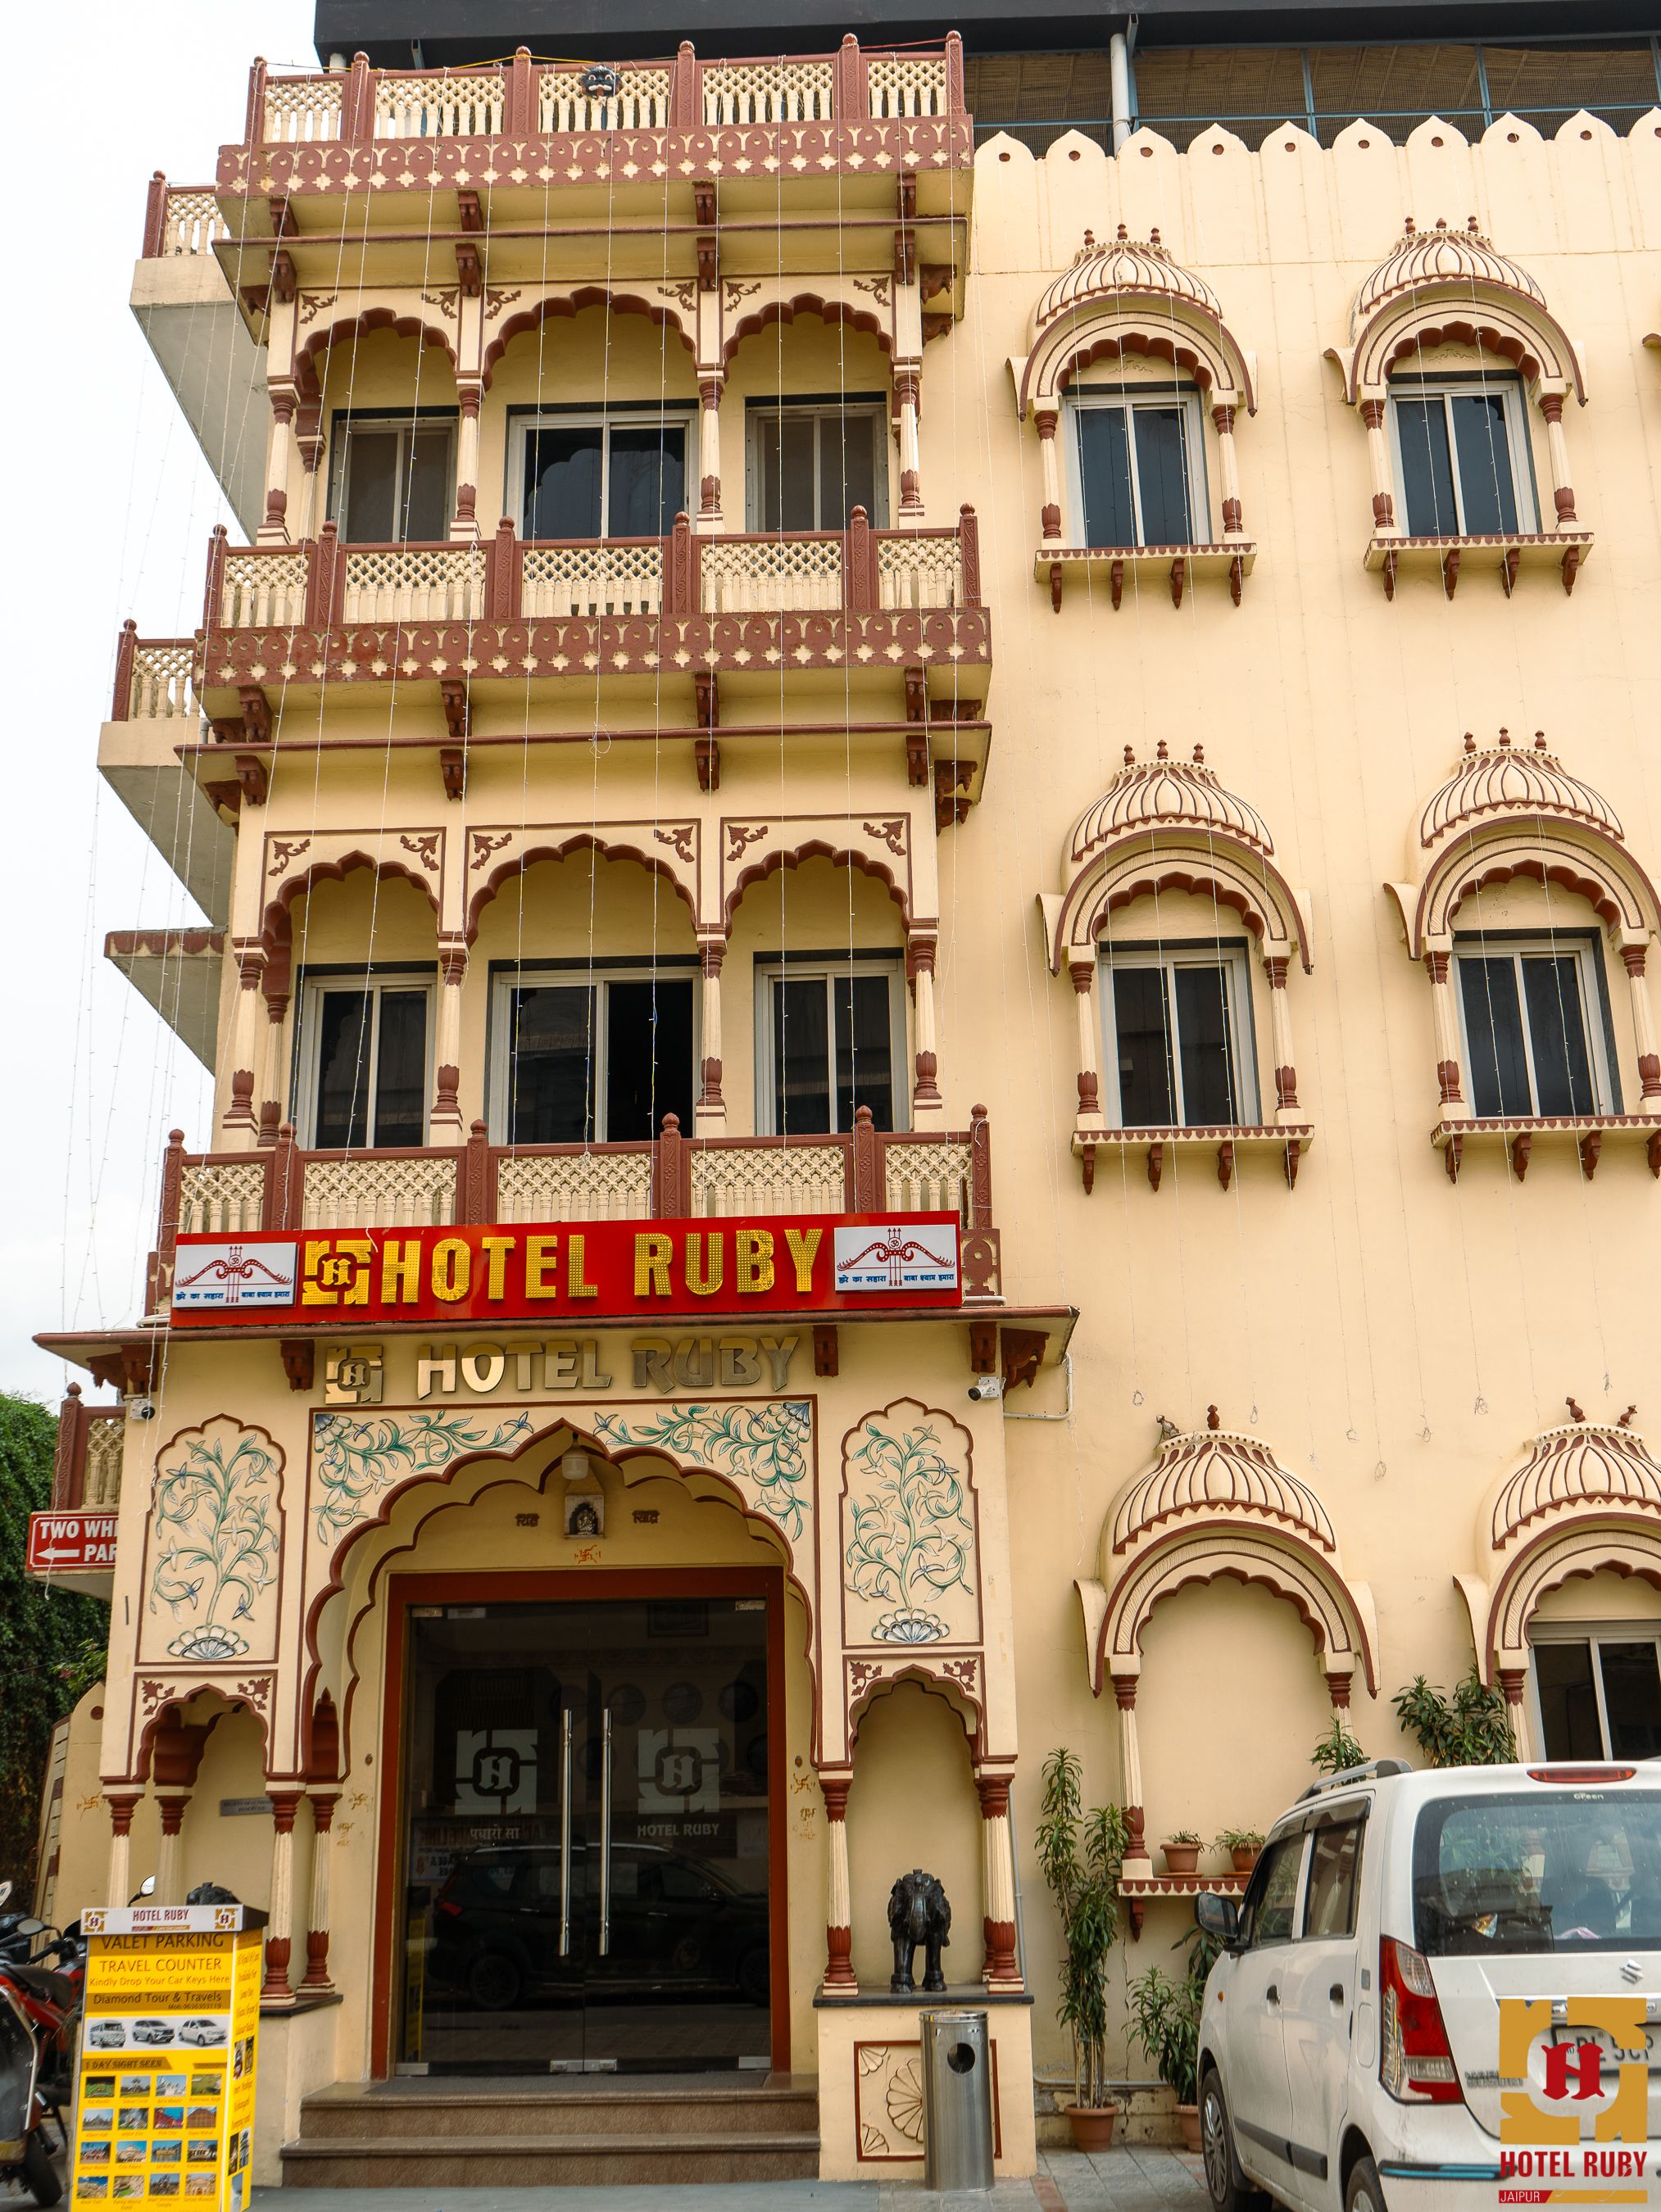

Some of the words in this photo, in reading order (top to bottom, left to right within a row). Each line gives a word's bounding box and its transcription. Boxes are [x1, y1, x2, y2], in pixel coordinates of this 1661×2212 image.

[381, 1234, 599, 1304] HOTEL
[633, 1228, 824, 1297] RUBY
[866, 1275, 887, 1283] सहारा
[190, 1292, 201, 1300] का
[203, 1292, 224, 1300] सहारा
[275, 1290, 290, 1299] हमारा
[417, 1339, 612, 1401] HOTEL
[631, 1336, 801, 1394] RUBY
[40, 1521, 79, 1539] TWO
[470, 1824, 501, 1841] पधारो
[506, 1827, 520, 1840] सा
[638, 1824, 679, 1837] HOTEL
[683, 1823, 719, 1837] RUBY
[133, 1910, 161, 1922] HOTEL
[164, 1909, 190, 1921] RUBY
[101, 1935, 150, 1950] VALET
[156, 1933, 224, 1949] PARKING
[99, 1960, 151, 1973] TRAVEL
[156, 1958, 222, 1972] COUNTER
[89, 1978, 117, 1988] Kindly
[120, 1977, 142, 1987] Drop
[144, 1976, 166, 1985] Your
[168, 1976, 184, 1984] Car
[186, 1975, 206, 1986] Keys
[209, 1974, 229, 1983] Here
[93, 1992, 142, 2005] Diamond
[144, 1992, 170, 2004] Tour
[172, 1992, 181, 2002] &
[184, 1991, 222, 2002] Travels
[92, 2060, 113, 2069] DAY
[112, 2060, 139, 2069] SIGHT
[139, 2060, 163, 2069] SEEN
